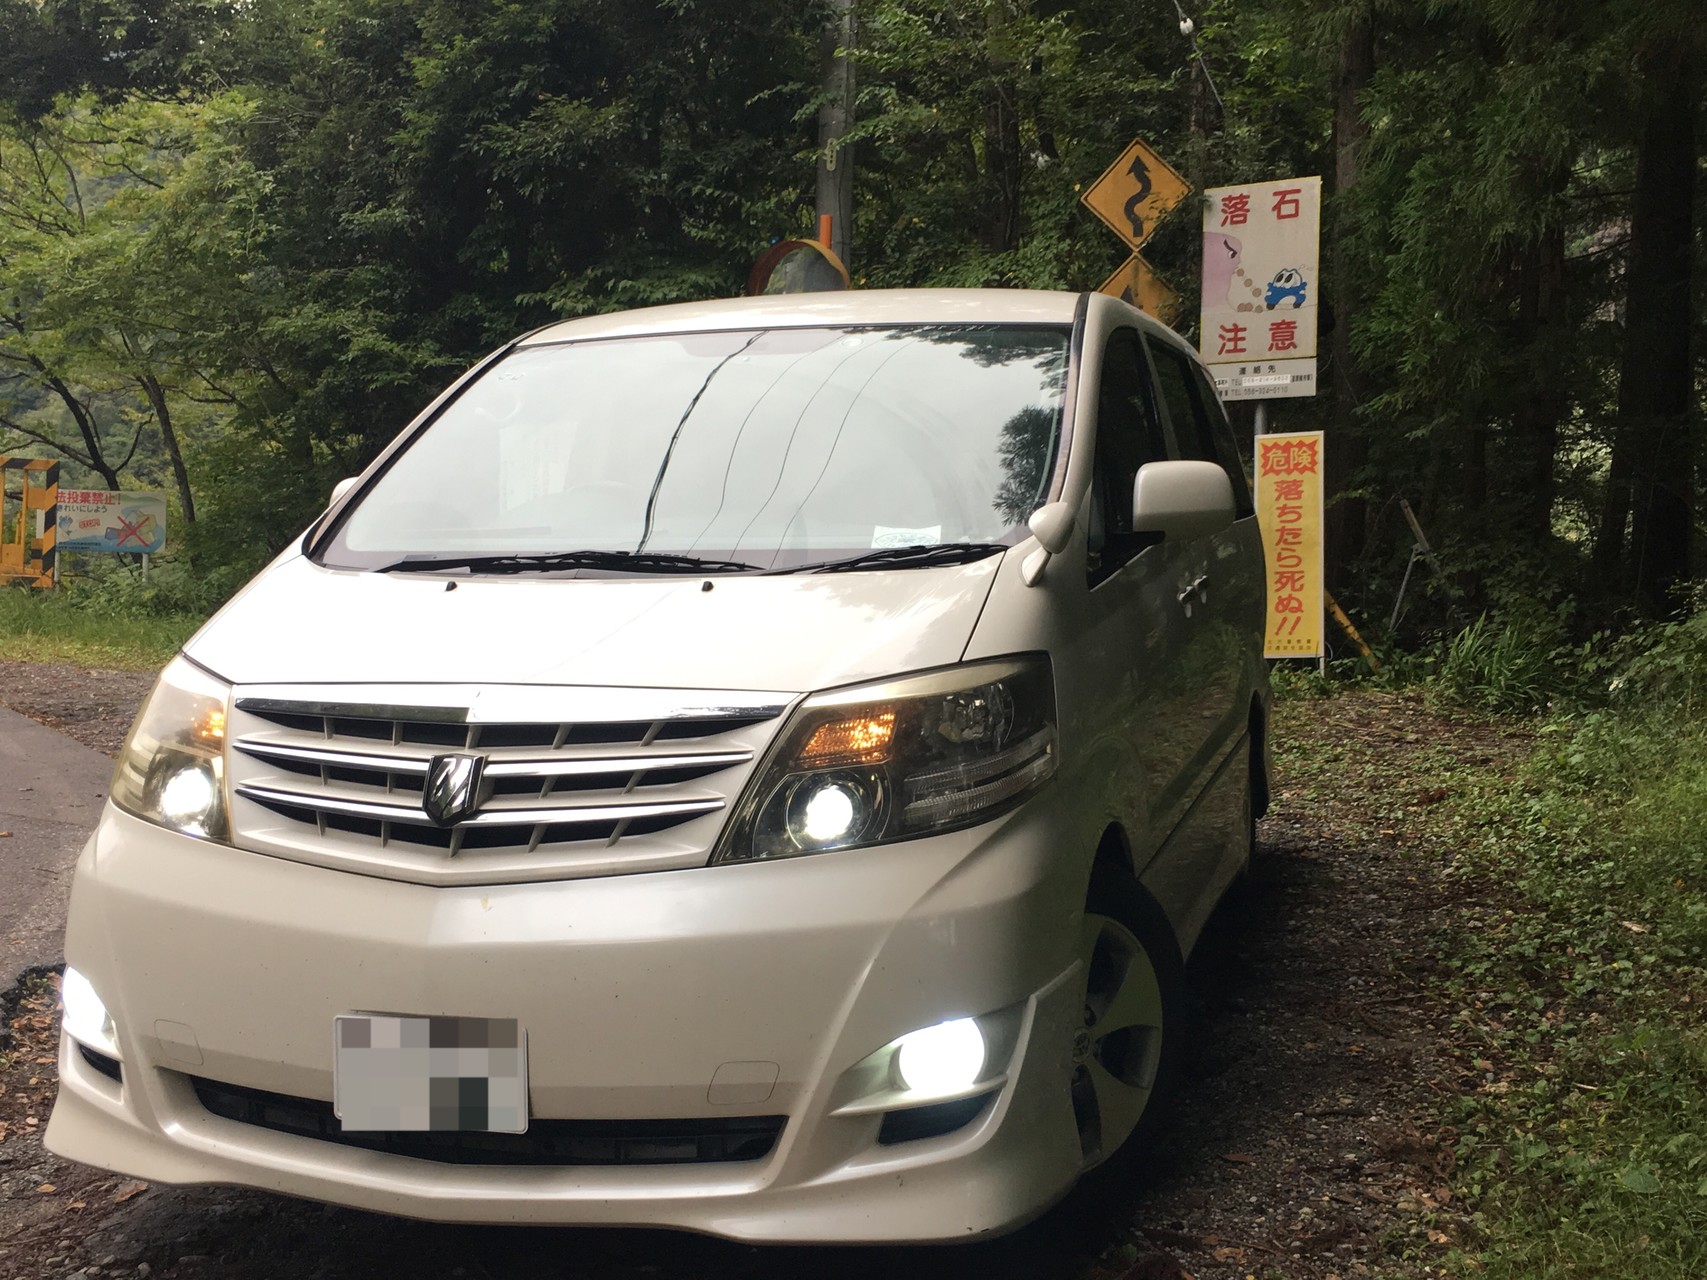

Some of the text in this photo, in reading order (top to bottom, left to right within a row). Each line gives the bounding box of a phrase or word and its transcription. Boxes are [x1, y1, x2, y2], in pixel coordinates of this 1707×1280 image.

[1220, 188, 1302, 227] 落石
[1217, 319, 1298, 355] 注意
[1265, 447, 1312, 470] 危険
